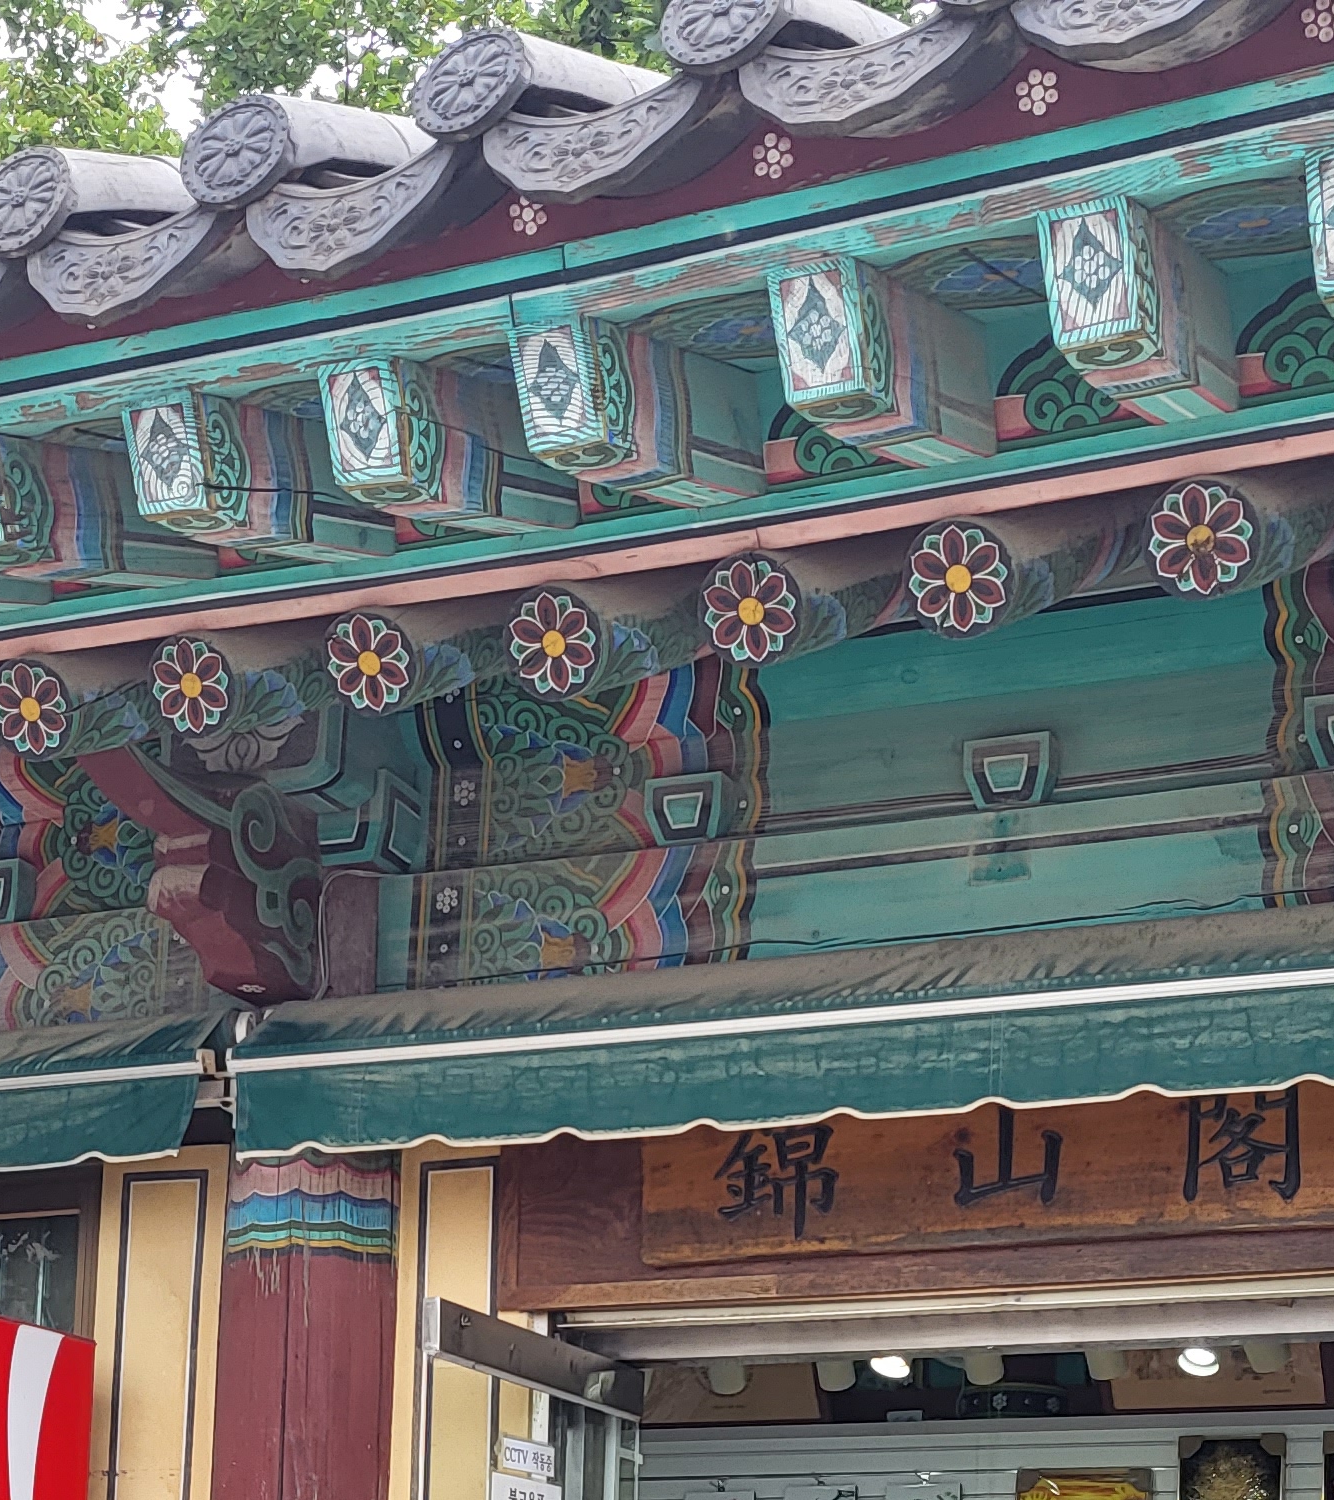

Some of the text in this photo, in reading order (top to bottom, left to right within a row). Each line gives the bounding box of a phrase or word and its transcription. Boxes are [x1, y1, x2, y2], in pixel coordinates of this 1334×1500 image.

[714, 1091, 1302, 1241] 錦山閣
[504, 1446, 553, 1473] CCTV 작동중
